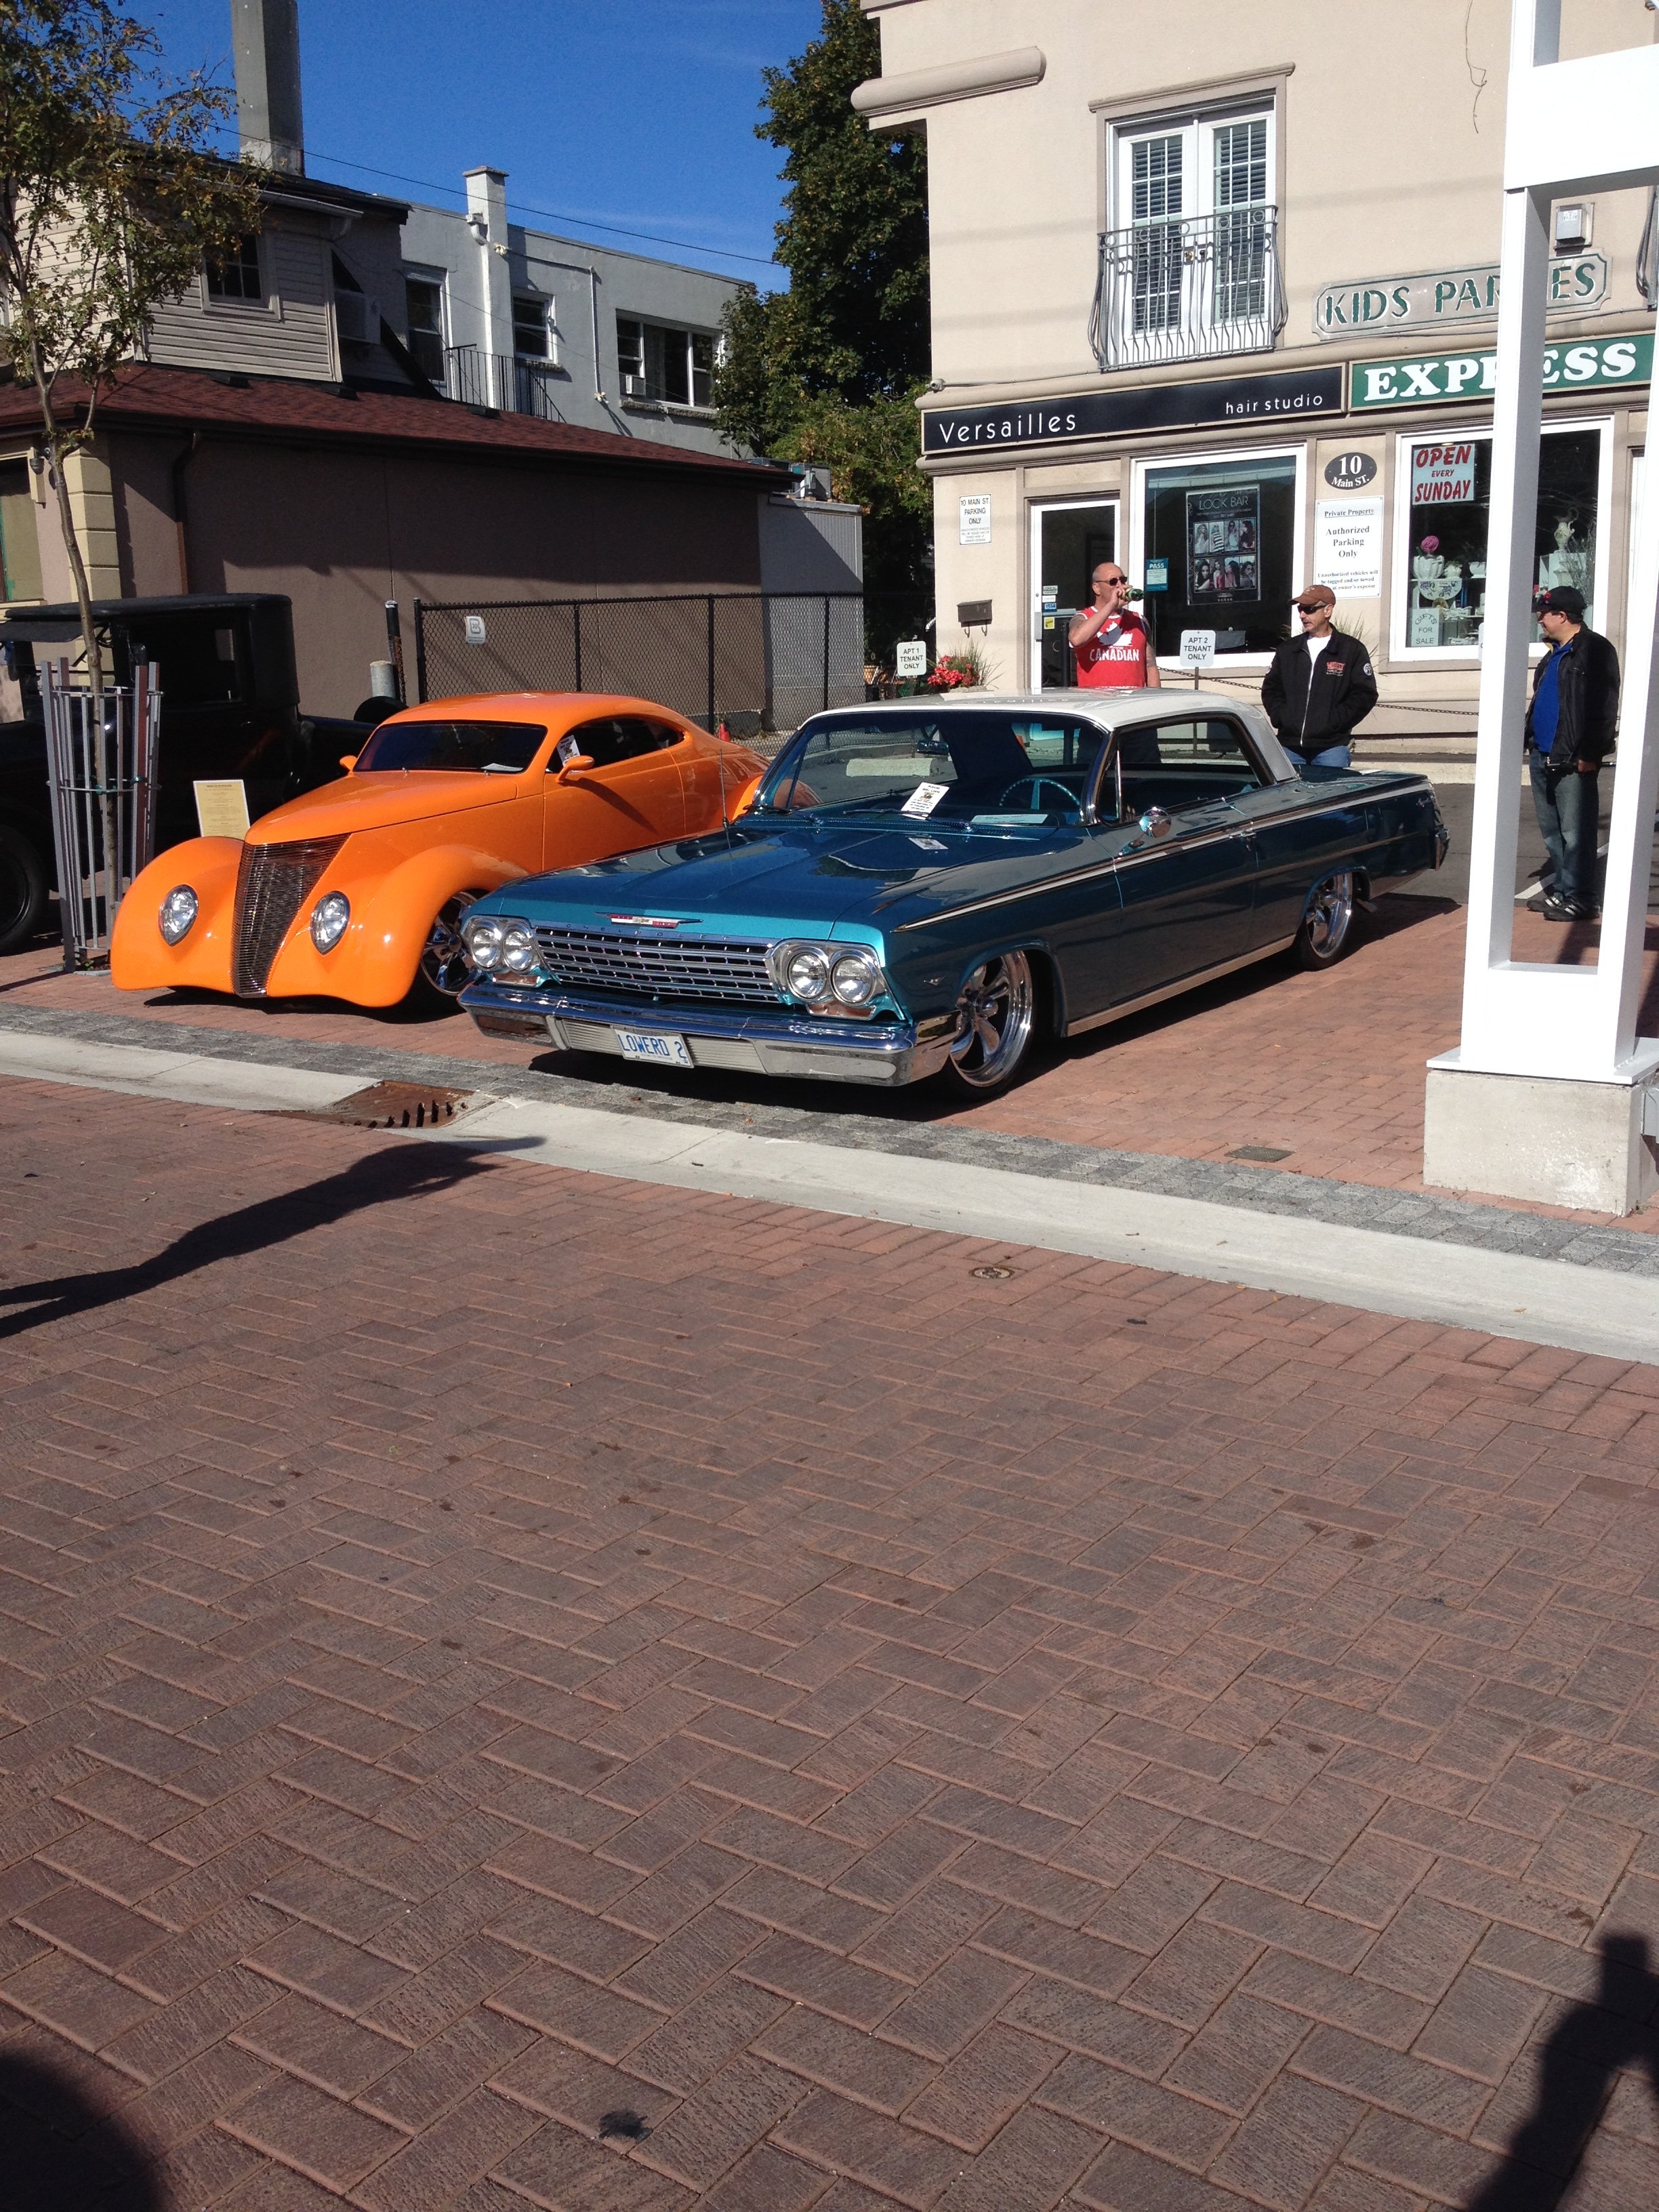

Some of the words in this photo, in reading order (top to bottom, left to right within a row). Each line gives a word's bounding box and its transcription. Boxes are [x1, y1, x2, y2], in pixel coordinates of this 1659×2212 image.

[1325, 285, 1410, 327] KIDS
[1225, 401, 1258, 415] hair
[1265, 394, 1324, 411] studio
[939, 413, 1077, 443] Versailles
[1416, 445, 1472, 468] OPEN
[1338, 455, 1361, 476] 10
[1331, 476, 1353, 487] Main
[1414, 480, 1471, 502] SUNDAY
[1199, 497, 1227, 510] LOCK
[1230, 495, 1248, 508] BAR
[964, 507, 986, 515] PARKING
[1326, 525, 1370, 535] Authorized
[1333, 537, 1364, 547] Parking
[1338, 550, 1358, 558] Only
[1415, 613, 1437, 625] GIFTS
[1090, 649, 1139, 661] CANADIAN
[617, 1034, 670, 1057] LOWERD
[674, 1041, 688, 1059] 2
